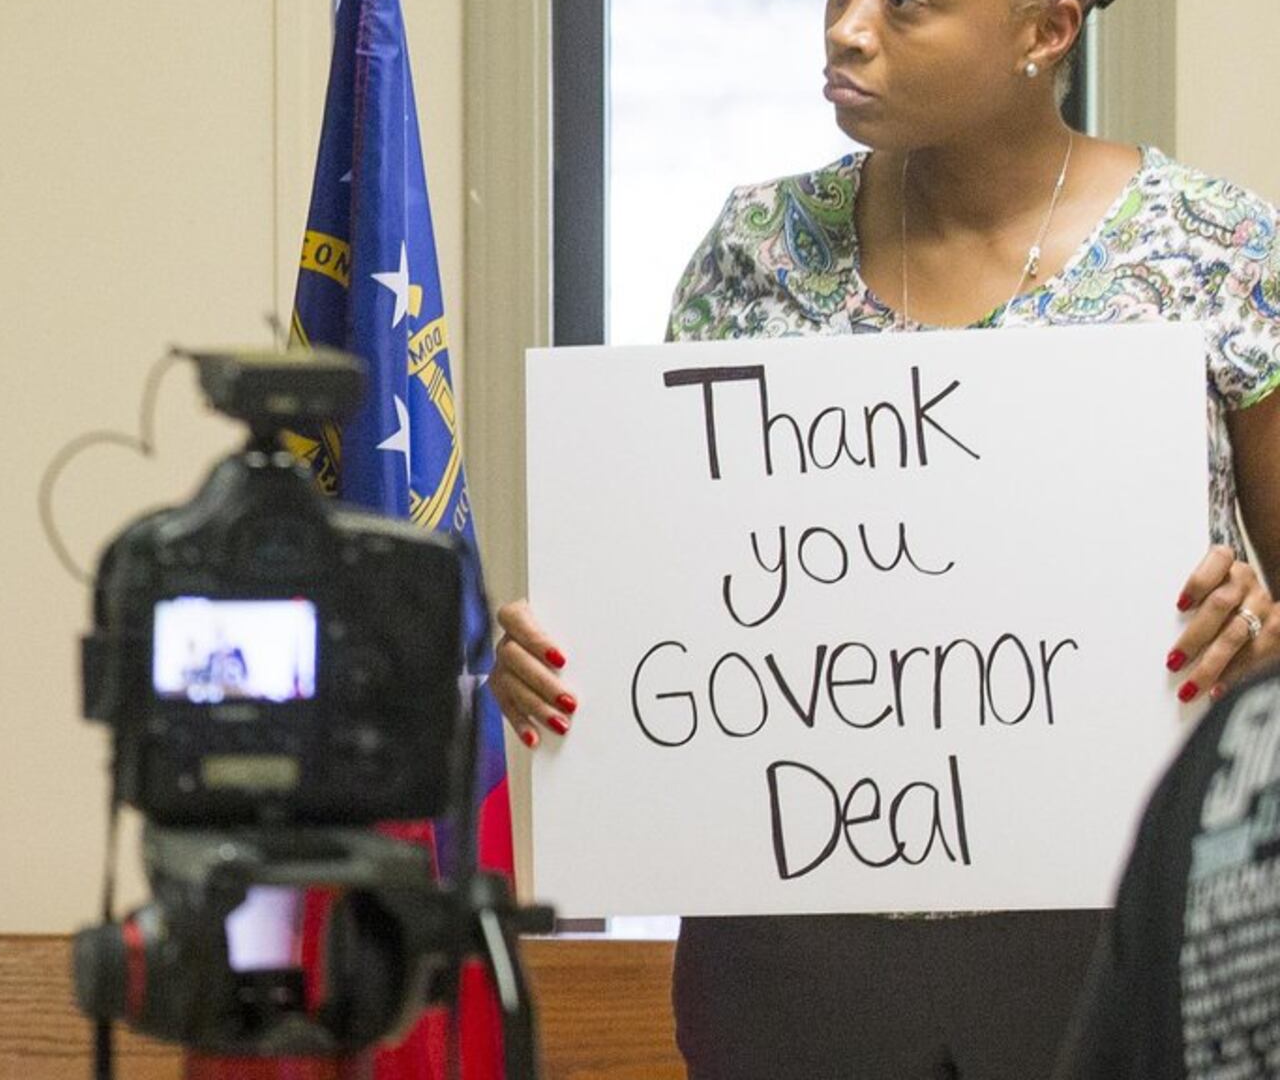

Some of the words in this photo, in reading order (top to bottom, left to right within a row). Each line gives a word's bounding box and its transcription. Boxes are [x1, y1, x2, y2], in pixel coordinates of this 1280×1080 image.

[663, 364, 981, 480] Thank
[722, 522, 955, 627] you
[630, 633, 1079, 747] Governor
[766, 754, 972, 880] Deal
